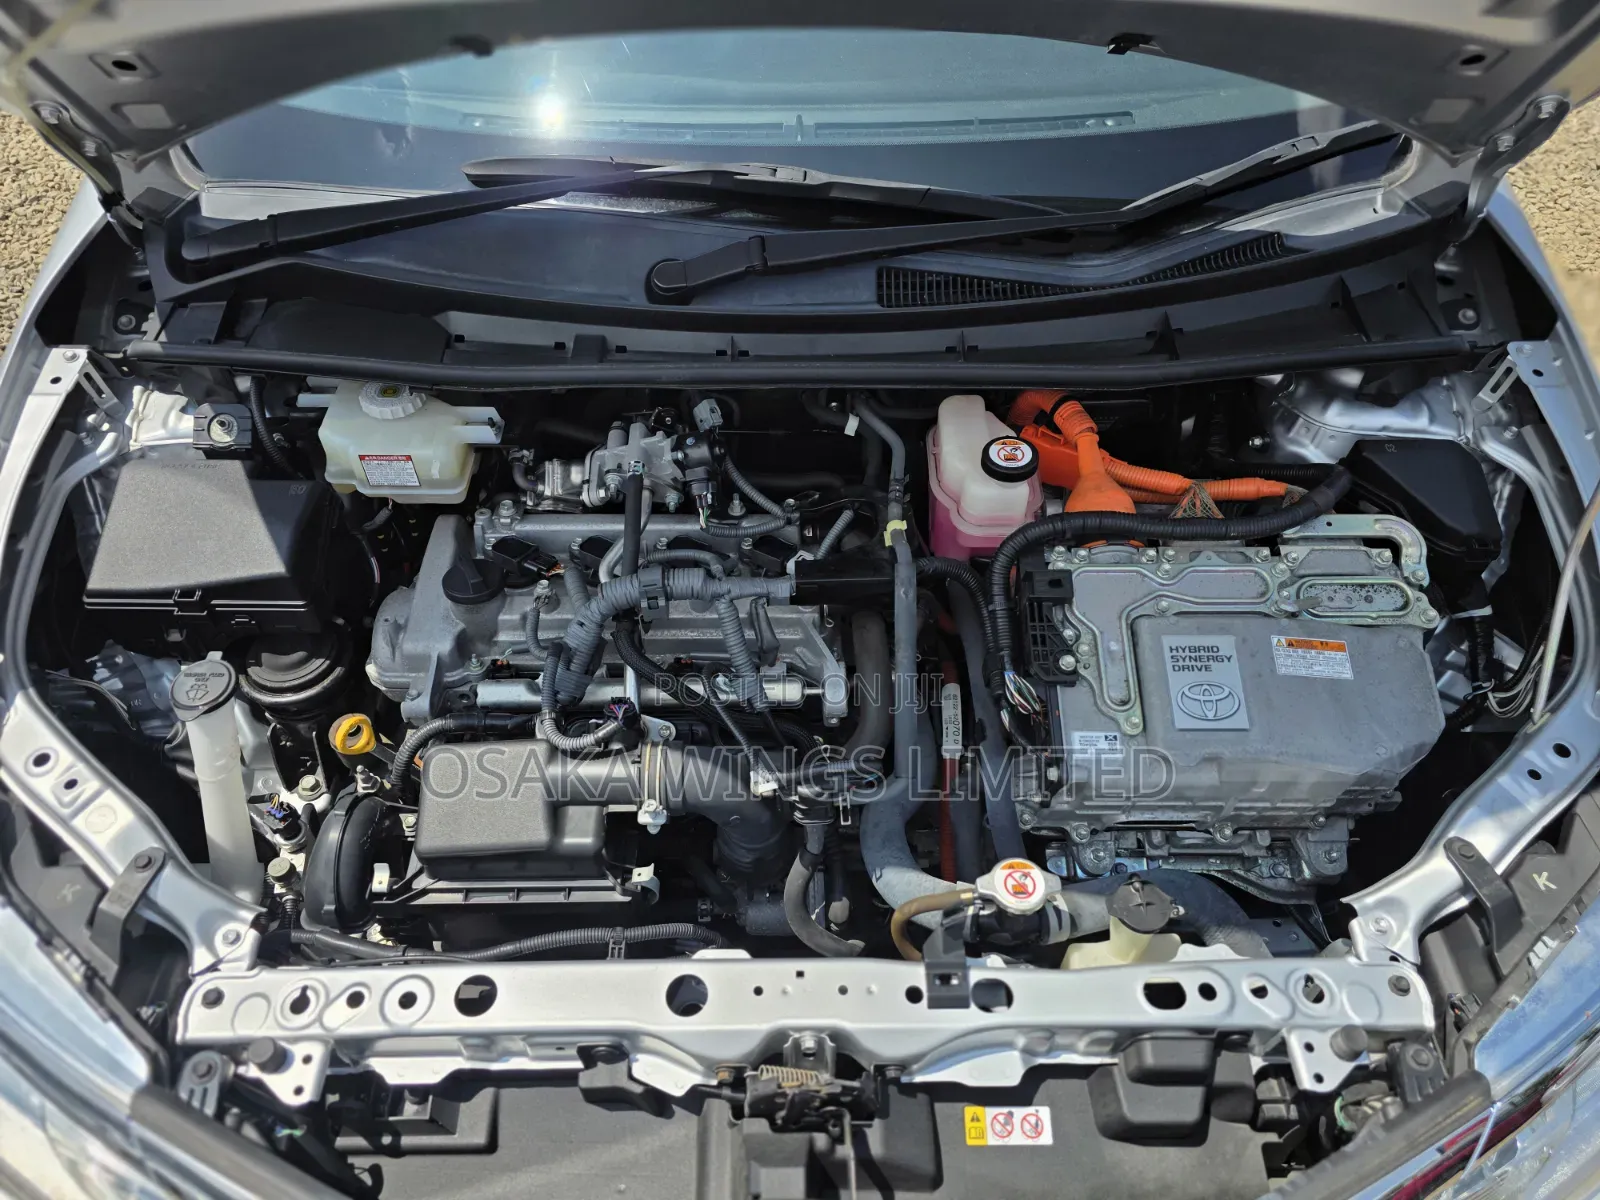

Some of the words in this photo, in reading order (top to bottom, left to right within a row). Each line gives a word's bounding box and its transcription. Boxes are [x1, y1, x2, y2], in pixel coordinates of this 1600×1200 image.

[1169, 645, 1220, 654] HYBRID
[1170, 654, 1233, 663] SYNERGY
[1172, 664, 1213, 672] DRIVE
[1532, 871, 1557, 891] K
